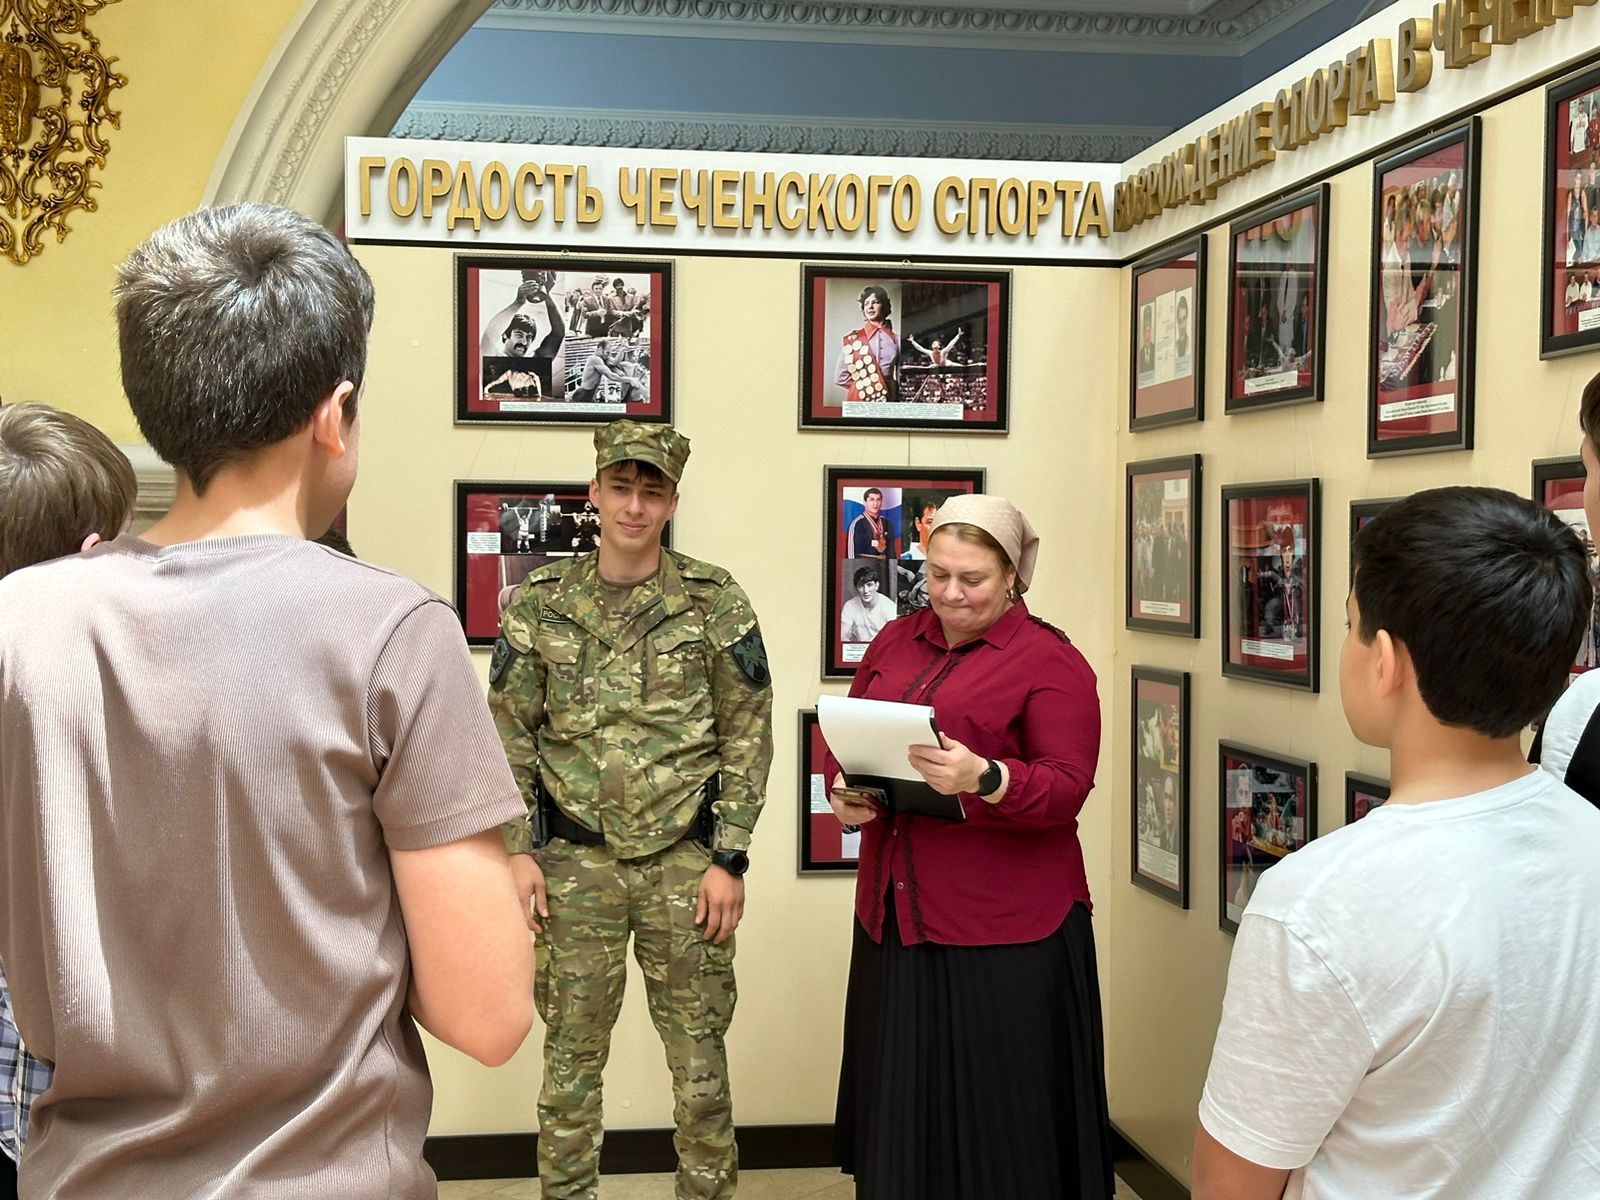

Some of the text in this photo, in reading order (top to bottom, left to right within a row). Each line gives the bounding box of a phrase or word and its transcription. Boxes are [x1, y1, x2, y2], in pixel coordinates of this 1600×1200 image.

[359, 156, 1109, 238] ГОРДОСТЬ ЧЕЧЕНСКОГО СПОРТА
[1113, 101, 1276, 232] ВОЗРОЖДЕНИЕ
[1272, 38, 1396, 151] СПОРТА
[1397, 17, 1433, 93] В
